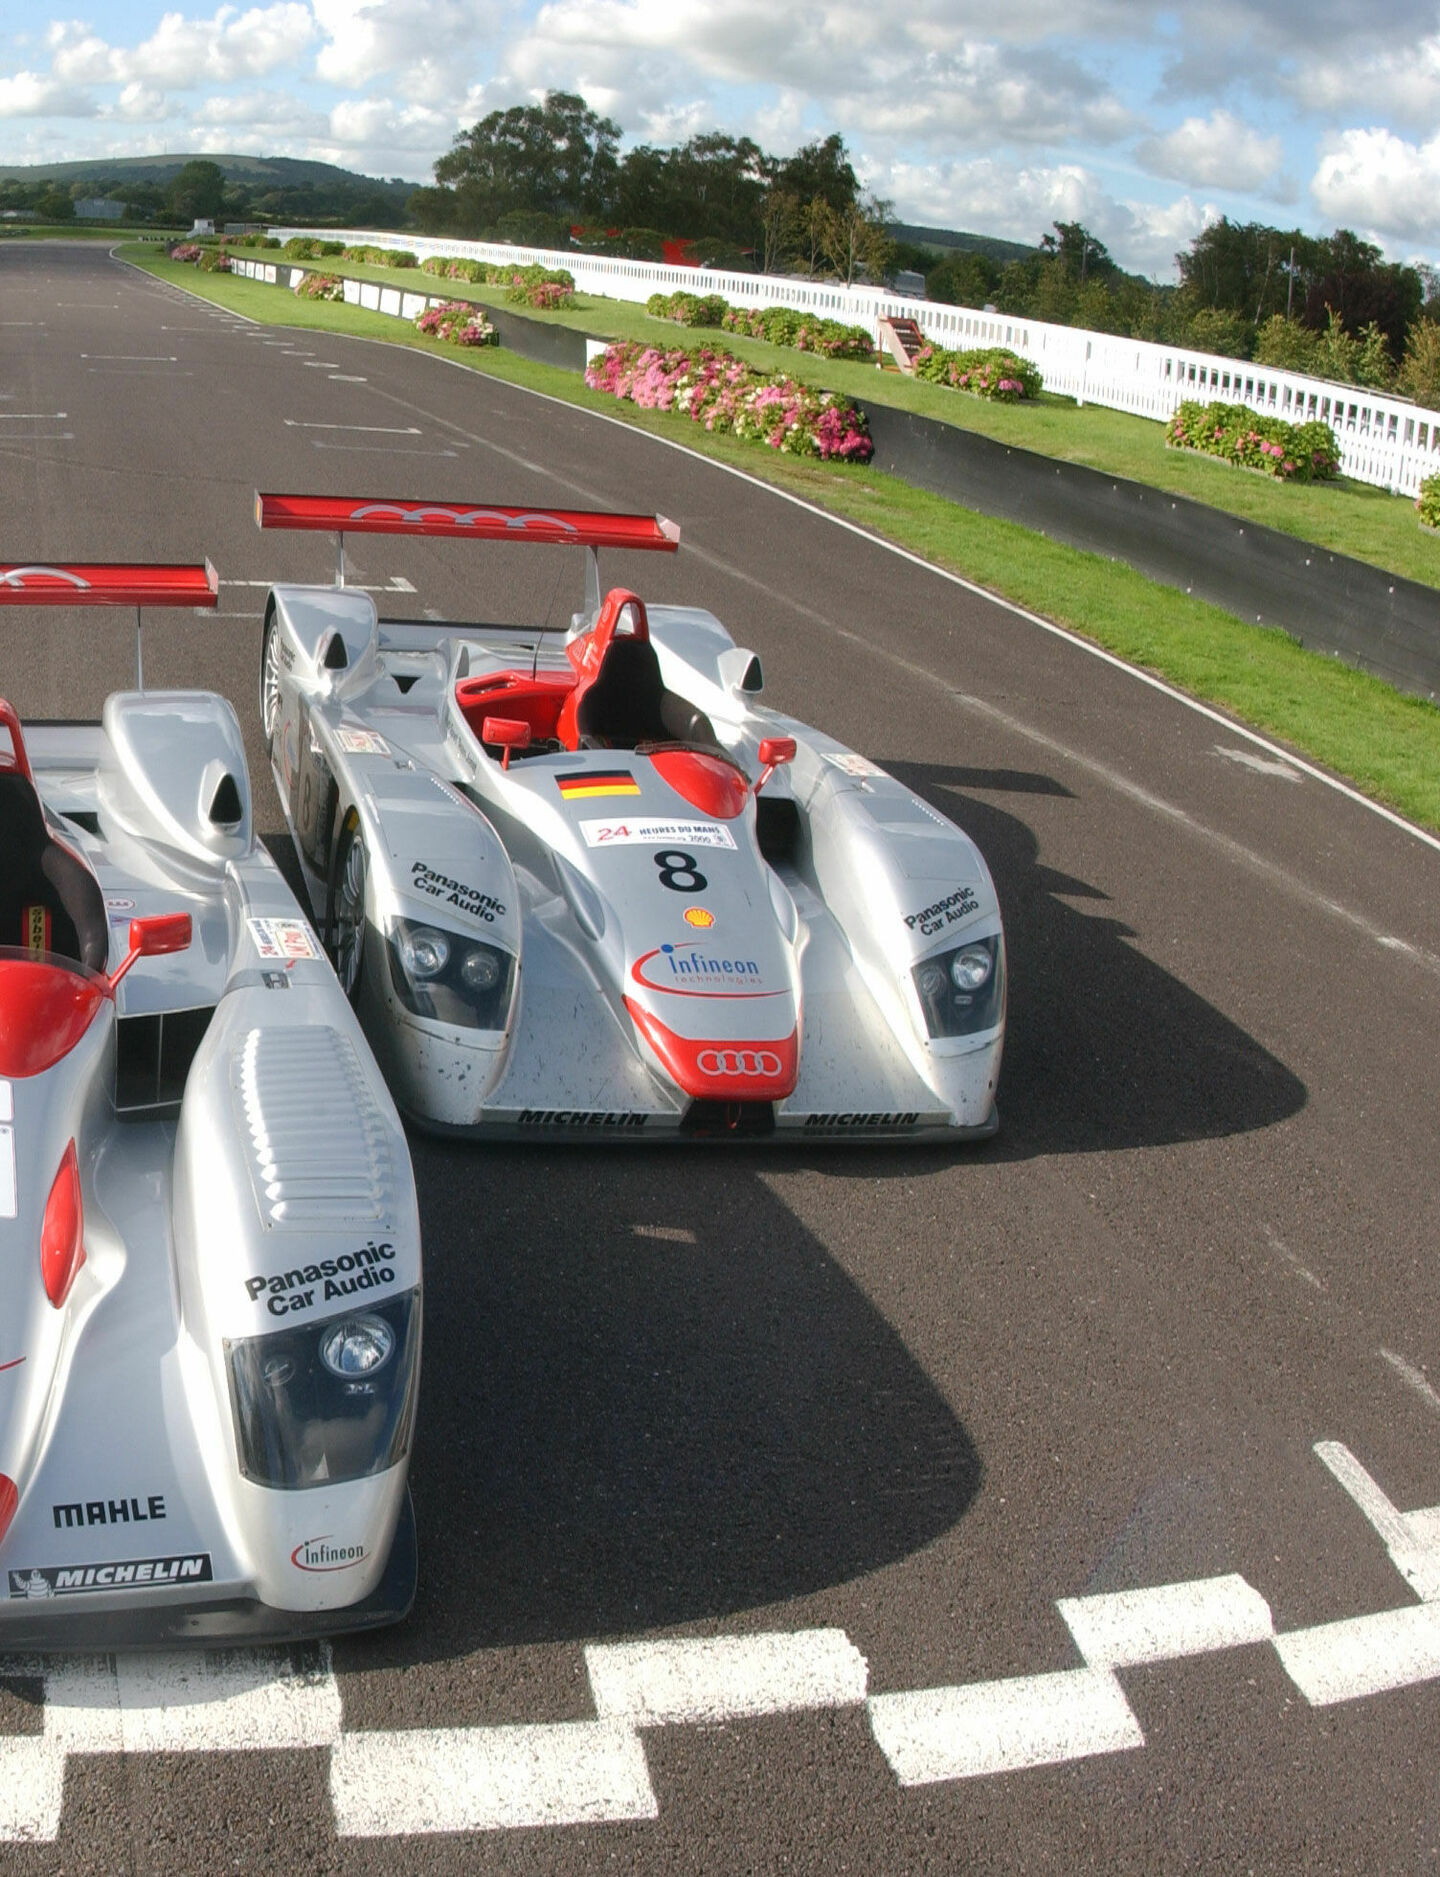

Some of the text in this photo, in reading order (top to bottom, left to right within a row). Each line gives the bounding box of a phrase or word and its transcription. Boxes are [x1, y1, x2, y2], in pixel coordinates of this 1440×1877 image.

[597, 825, 632, 842] 24
[639, 826, 676, 835] HEURES
[693, 826, 720, 834] MANS
[688, 835, 711, 844] 2000
[411, 861, 507, 915] Panasonic
[654, 850, 708, 893] 8
[413, 877, 495, 922] Car Audio
[904, 887, 974, 930] Panasonic
[920, 900, 979, 936] Car Audio
[674, 975, 764, 985] technologies
[517, 1110, 649, 1126] MICHELIN
[804, 1112, 920, 1127] MICHELIN
[245, 1241, 396, 1302] Panasonic
[267, 1266, 395, 1316] Car Audio
[53, 1496, 167, 1528] MAHLE
[55, 1558, 203, 1588] MICHELIN
